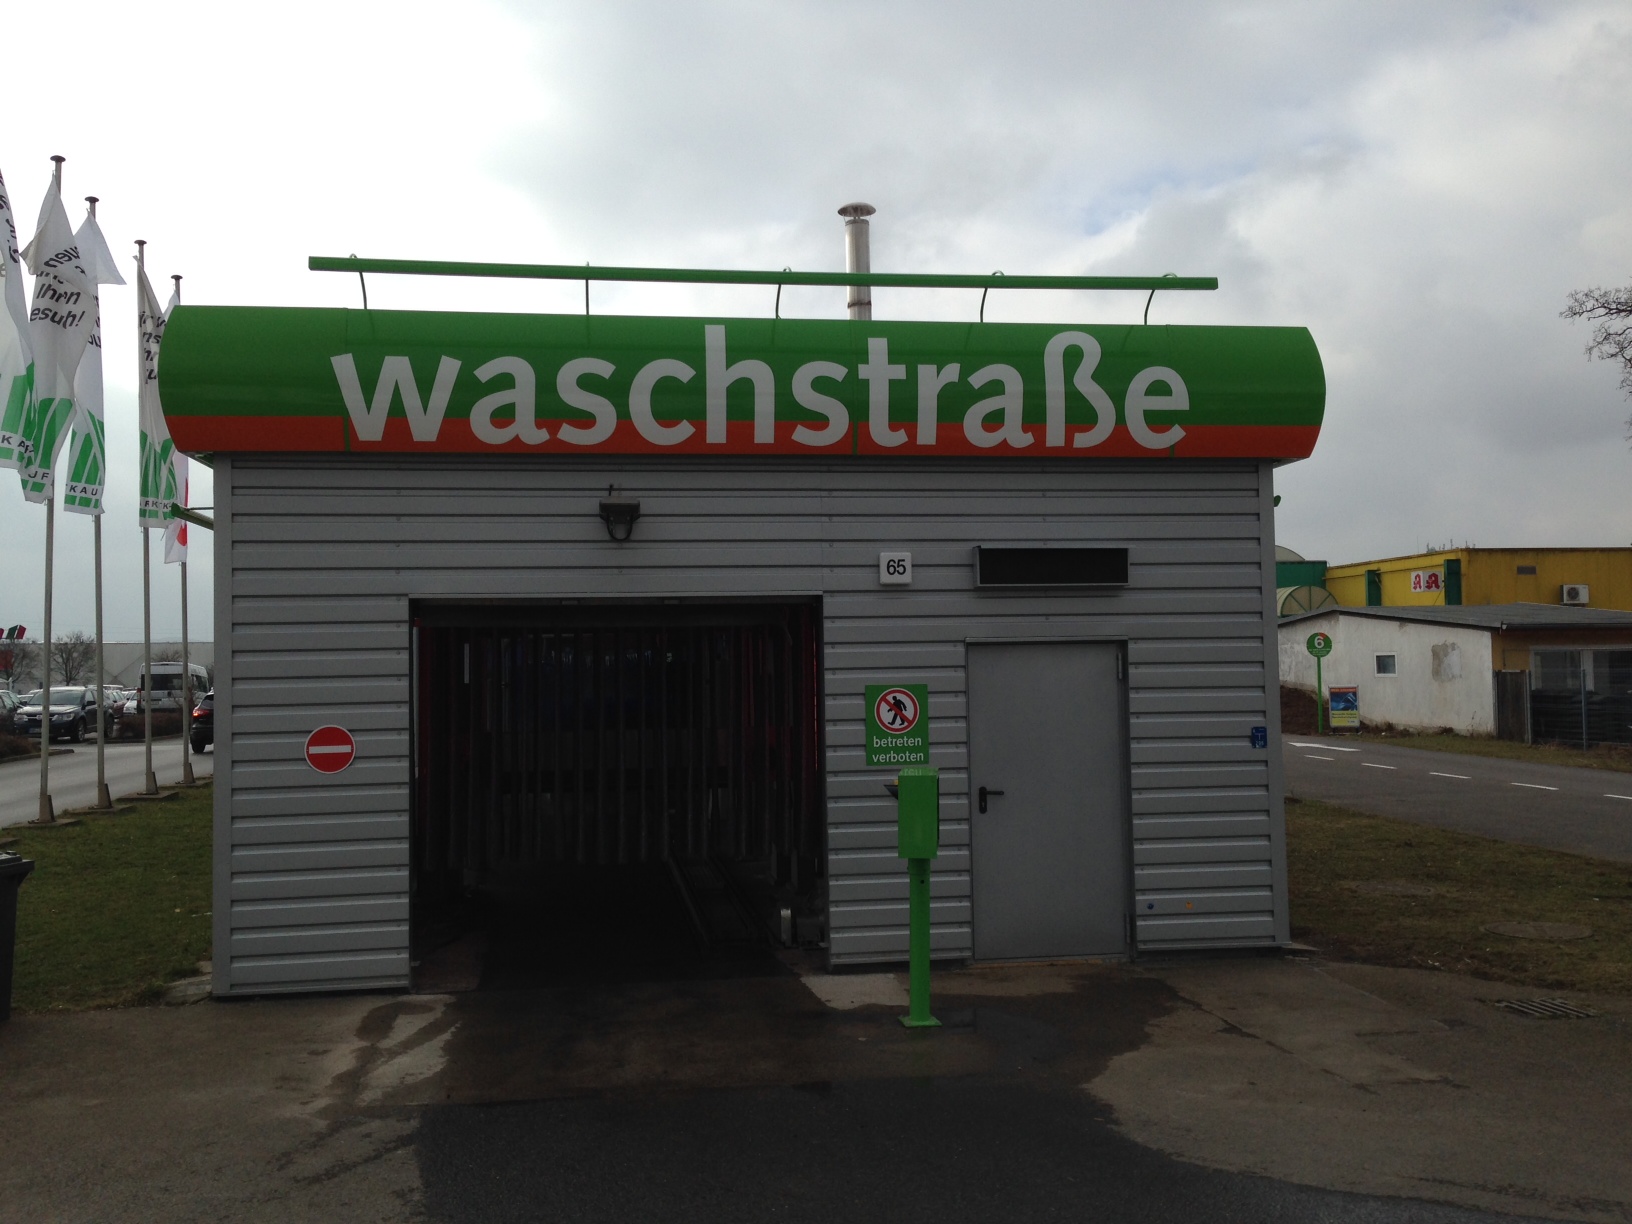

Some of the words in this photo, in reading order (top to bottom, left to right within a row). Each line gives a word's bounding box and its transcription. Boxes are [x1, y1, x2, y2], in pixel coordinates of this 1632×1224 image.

[330, 324, 1190, 449] waschstraße
[886, 558, 907, 576] 65
[1314, 636, 1325, 649] 6
[873, 735, 922, 748] betreten
[872, 751, 924, 763] verboten
